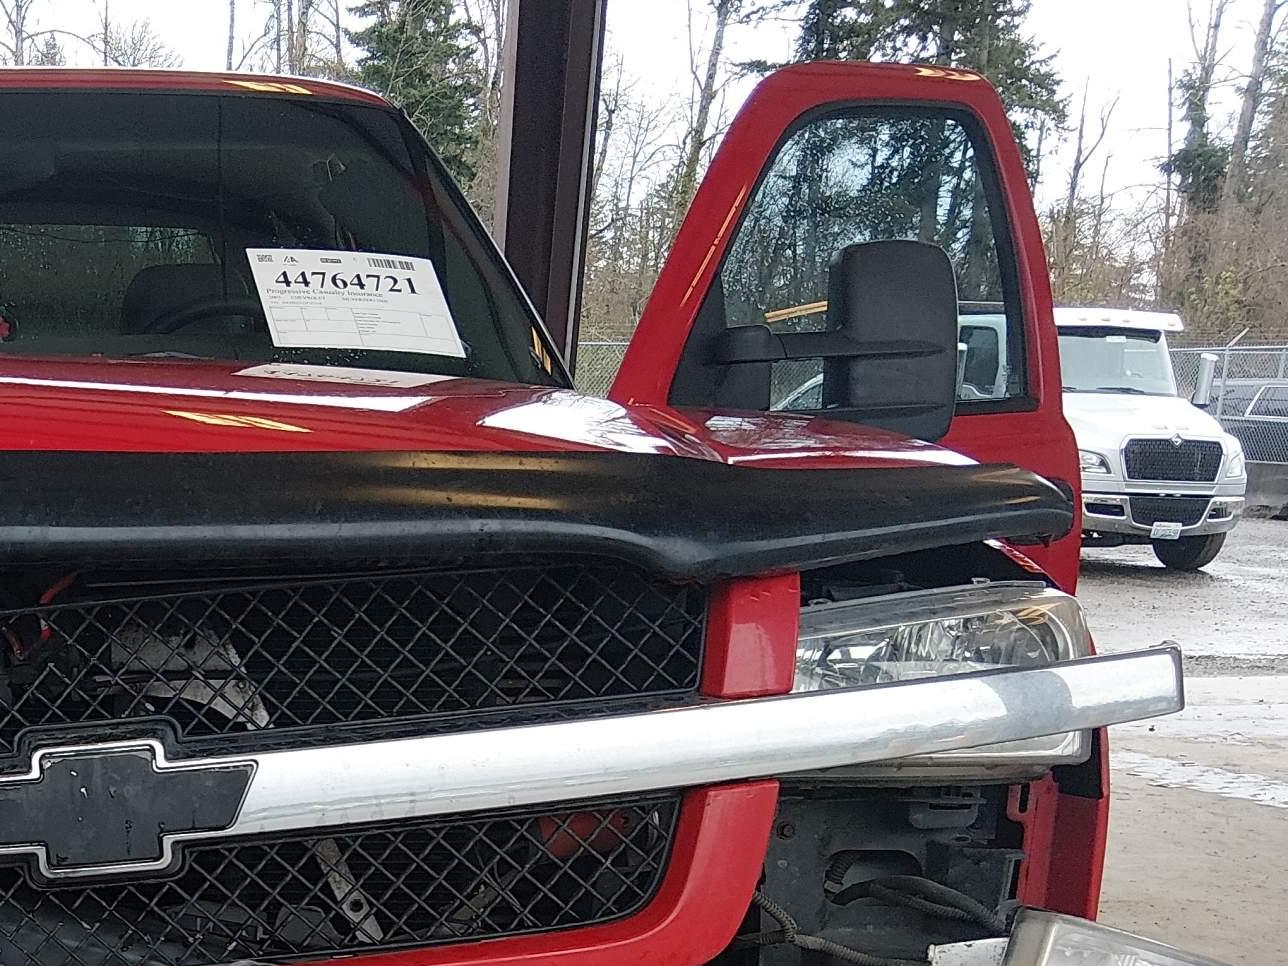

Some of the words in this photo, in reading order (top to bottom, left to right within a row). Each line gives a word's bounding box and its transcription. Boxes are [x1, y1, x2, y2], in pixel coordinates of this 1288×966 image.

[274, 270, 421, 296] 44764721
[266, 288, 311, 296] Progressive
[313, 289, 345, 297] Casualty
[347, 290, 384, 298] Insurance
